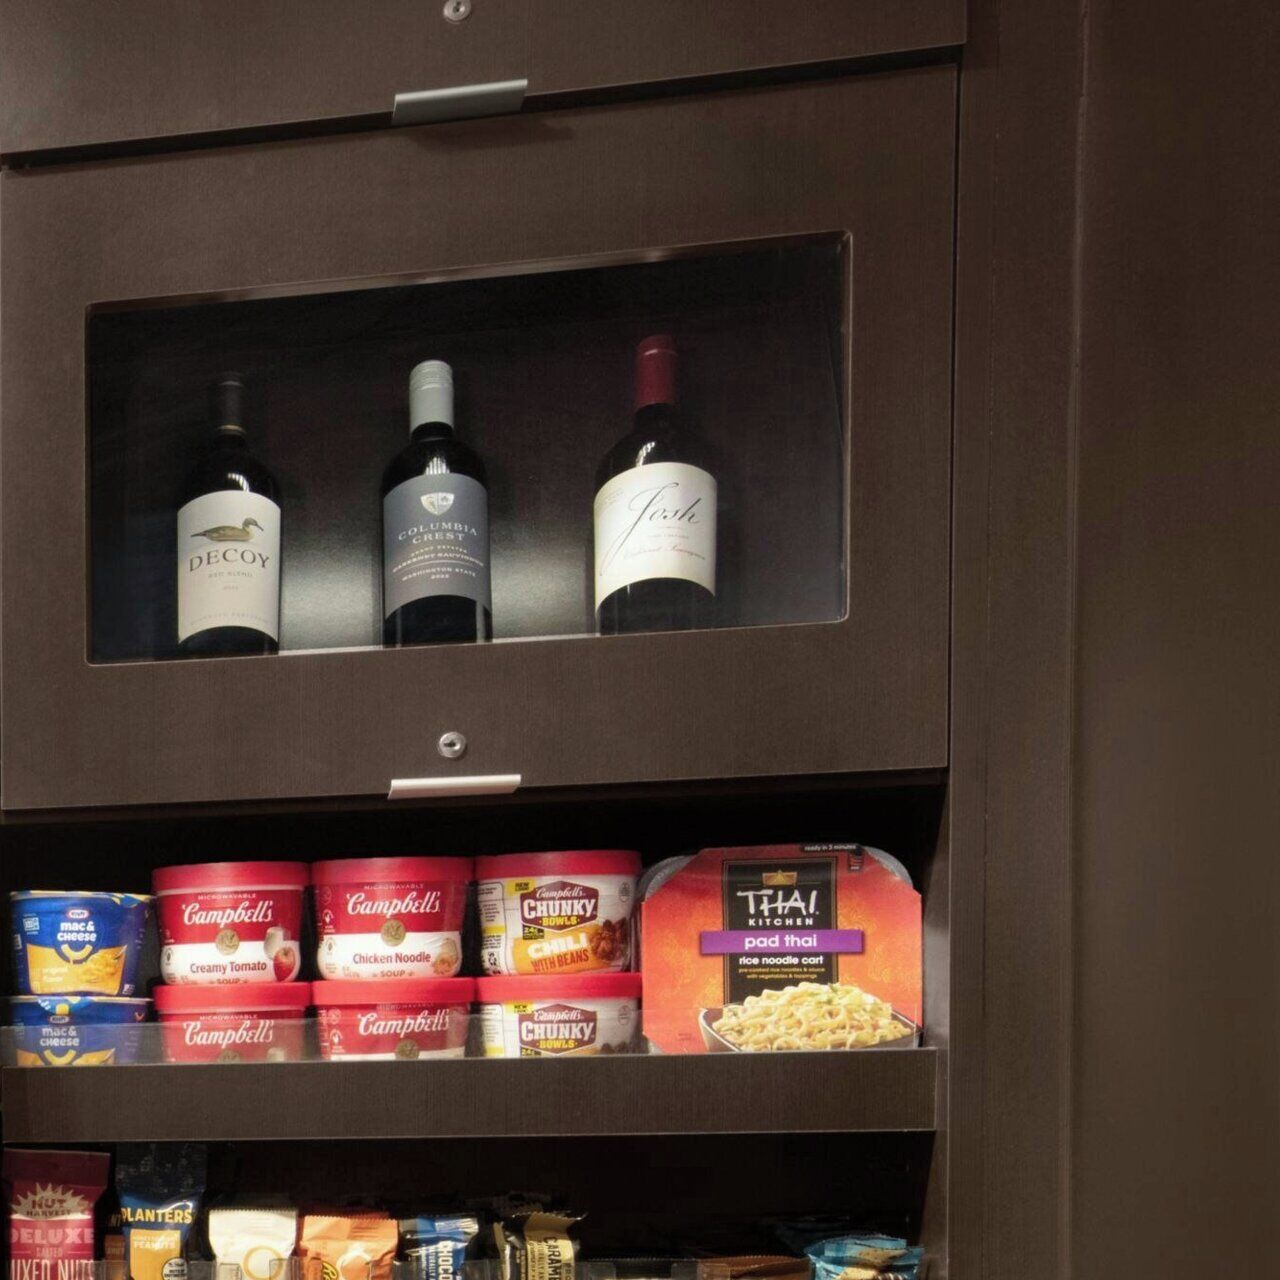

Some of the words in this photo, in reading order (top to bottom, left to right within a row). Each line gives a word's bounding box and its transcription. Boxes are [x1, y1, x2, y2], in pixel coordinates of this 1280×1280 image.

[398, 522, 479, 540] COLUMBIA
[412, 532, 465, 544] CREST
[189, 548, 270, 572] DECOY
[346, 891, 441, 919] Campbell's
[523, 898, 596, 920] CHUNKY
[737, 889, 816, 917] THAI
[182, 900, 274, 928] Campbell's
[542, 916, 578, 926] BOWLS
[749, 917, 814, 926] KITCHEN
[60, 922, 85, 932] mac
[527, 932, 588, 959] CHILI
[744, 934, 779, 950] pad
[784, 934, 818, 948] thai
[353, 953, 393, 965] Chicken
[395, 952, 432, 964] Noodle
[531, 955, 557, 972] WITH
[557, 949, 589, 965] BEANS
[739, 956, 760, 965] rice
[762, 955, 800, 965] noodle
[801, 956, 824, 965] cart
[190, 962, 227, 975] Creamy
[230, 961, 267, 972] Tomato
[357, 1008, 450, 1039] Campbell's
[521, 1021, 594, 1042] CHUNKY
[183, 1019, 275, 1049] Campbell's
[539, 1038, 575, 1049] BOWLS
[31, 1199, 67, 1210] NUT
[121, 1207, 193, 1224] PLANTERS
